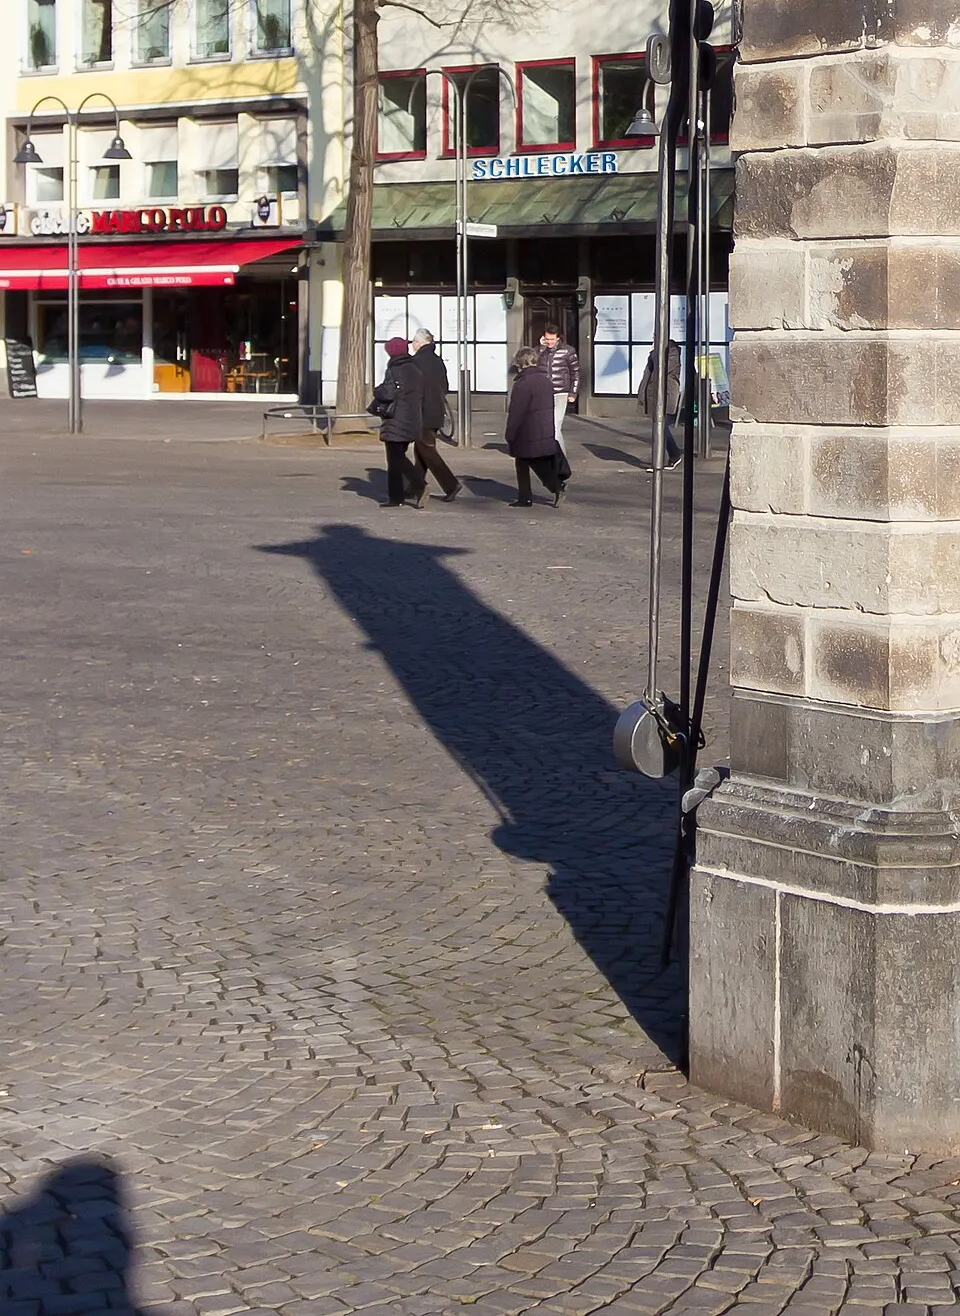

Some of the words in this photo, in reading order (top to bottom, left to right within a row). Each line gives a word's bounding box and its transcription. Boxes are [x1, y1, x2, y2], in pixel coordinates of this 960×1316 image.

[472, 153, 617, 180] SCHLECKER
[91, 209, 166, 234] MARCO
[168, 206, 228, 232] POLO
